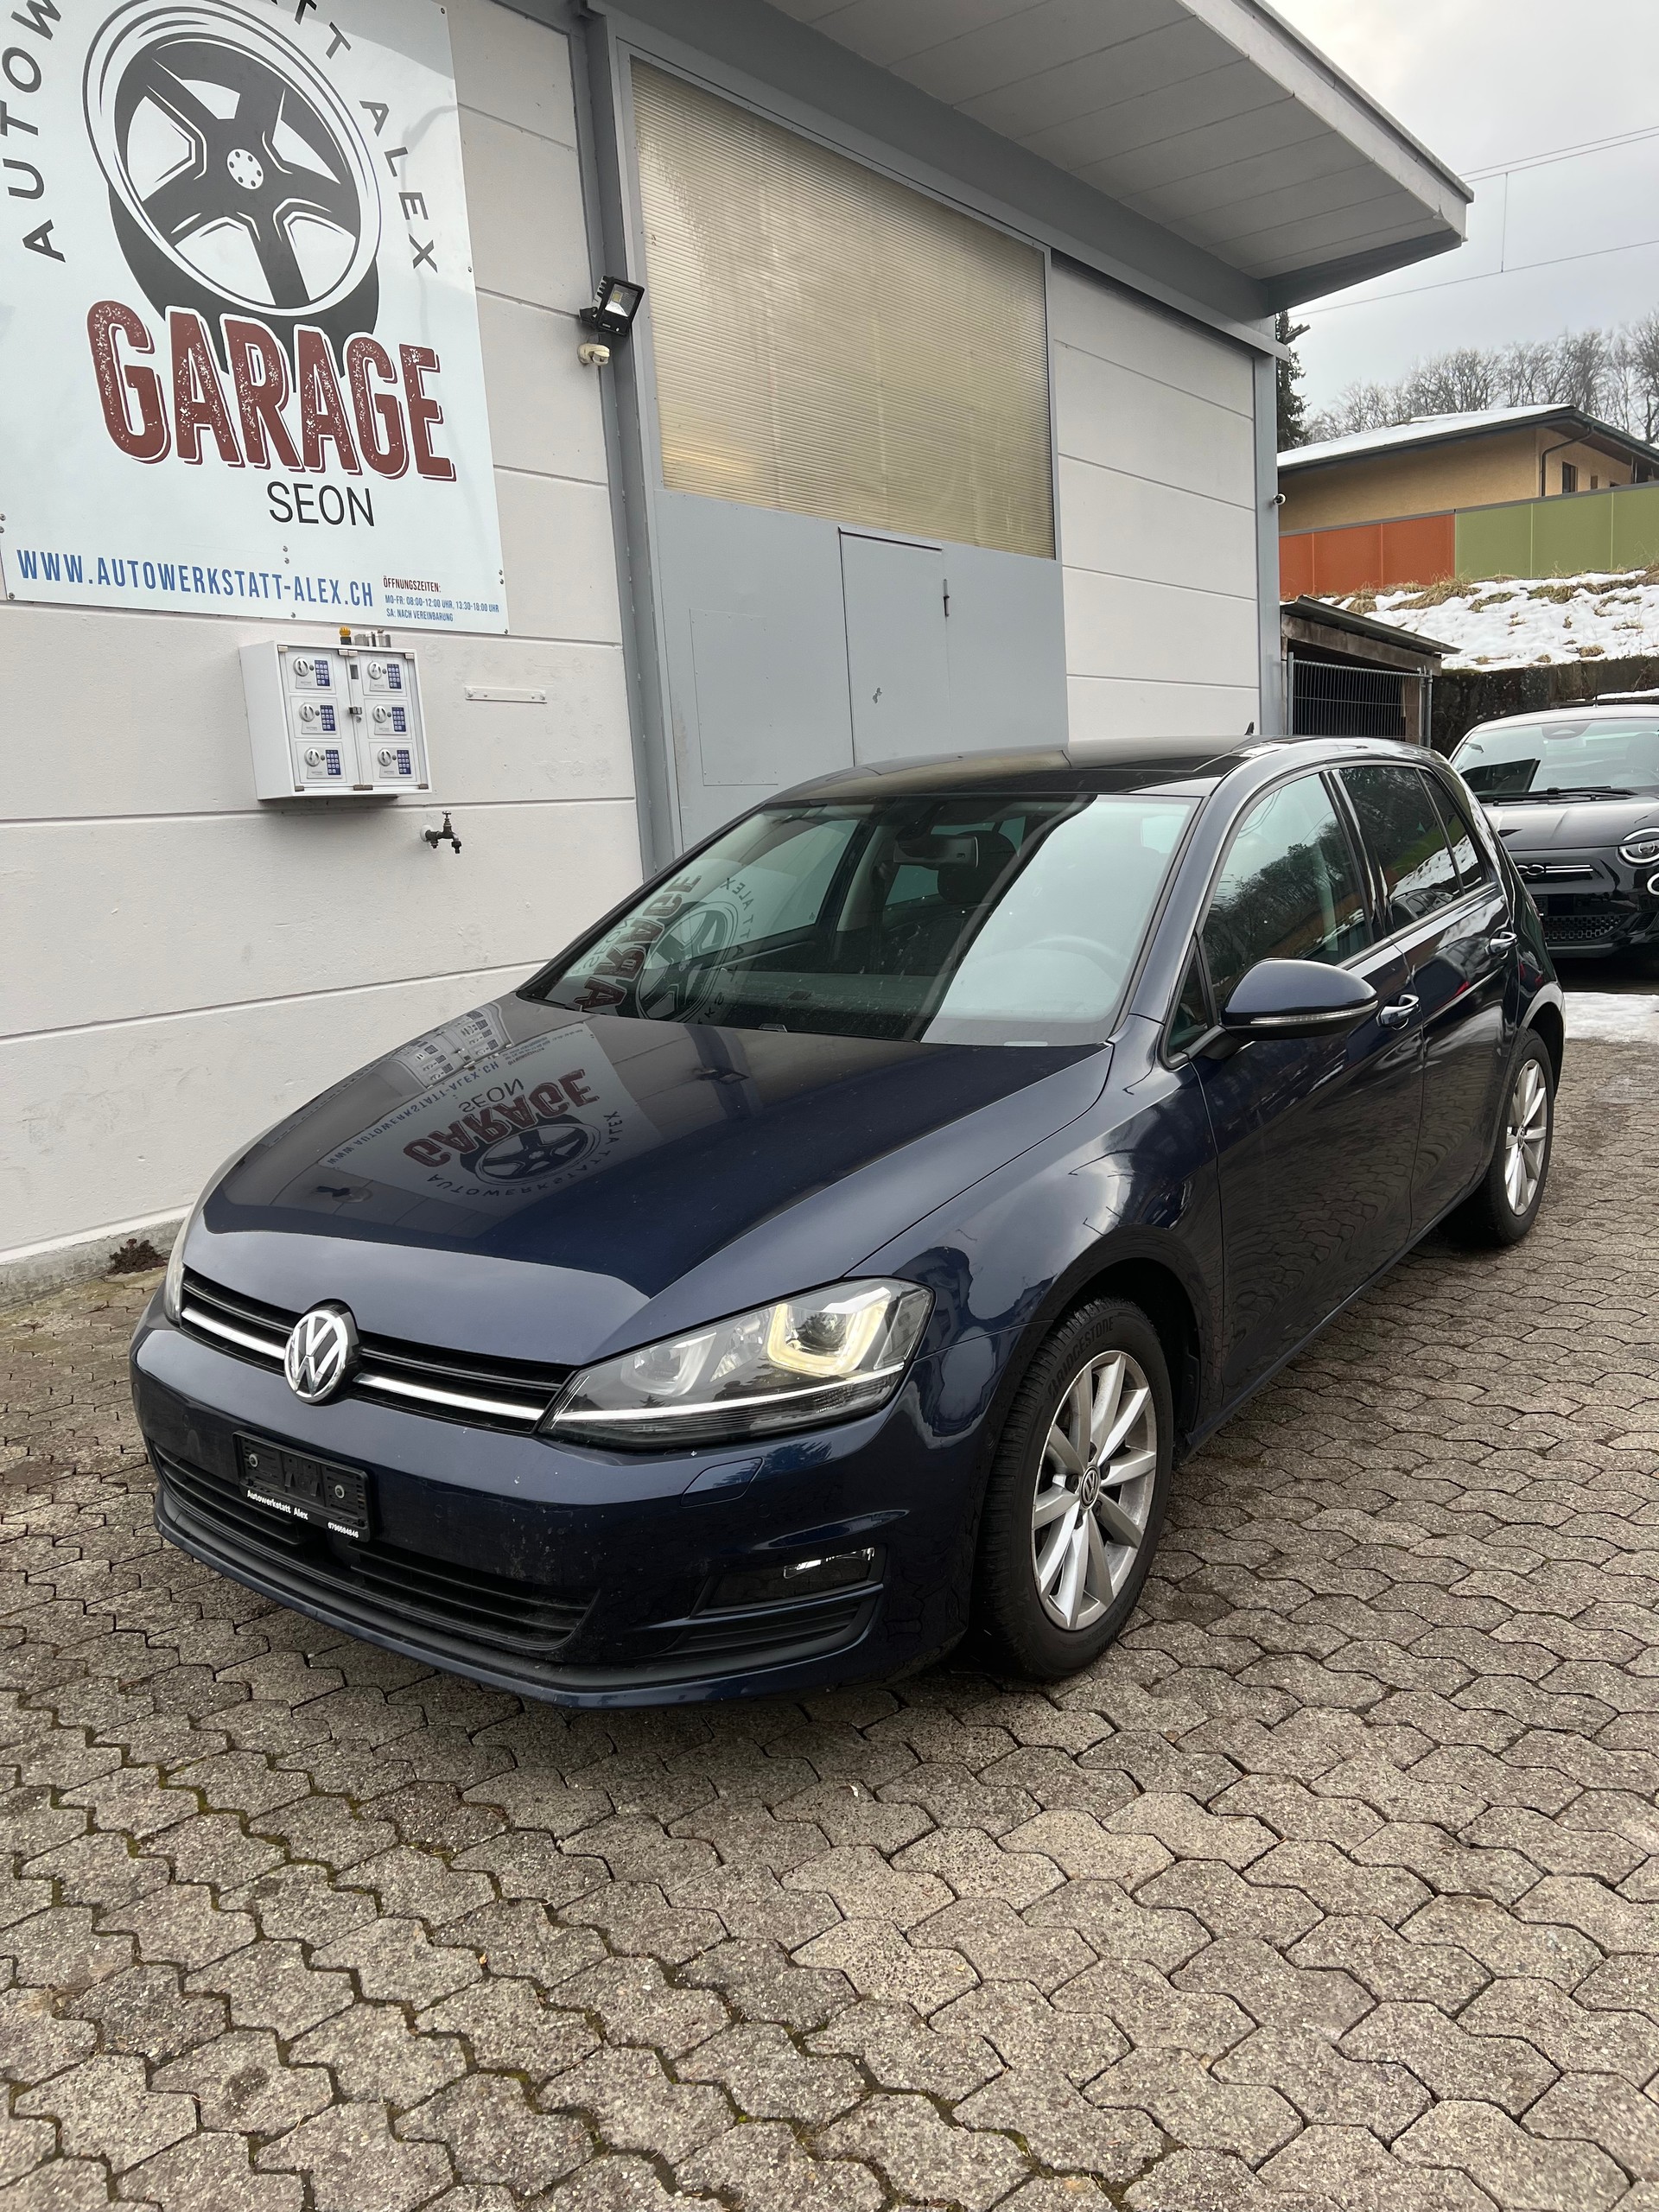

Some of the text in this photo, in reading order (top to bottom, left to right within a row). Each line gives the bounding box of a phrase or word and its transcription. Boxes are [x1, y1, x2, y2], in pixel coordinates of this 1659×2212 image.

[359, 99, 438, 274] ALEX
[87, 300, 457, 482] GARAGE
[267, 481, 375, 527] SEON
[16, 549, 373, 607] WWW.AUTOWERKSTATT-ALEX.CH
[383, 575, 442, 593] ÖFFNUNGSZEITEN:
[385, 594, 499, 613] MO-FR: 08:00-12:00 UHR, 13:30-18:00 UHR
[386, 608, 454, 622] SA: NACH VEREINBARUNG
[246, 1489, 308, 1521] Autowerkstatt Alex
